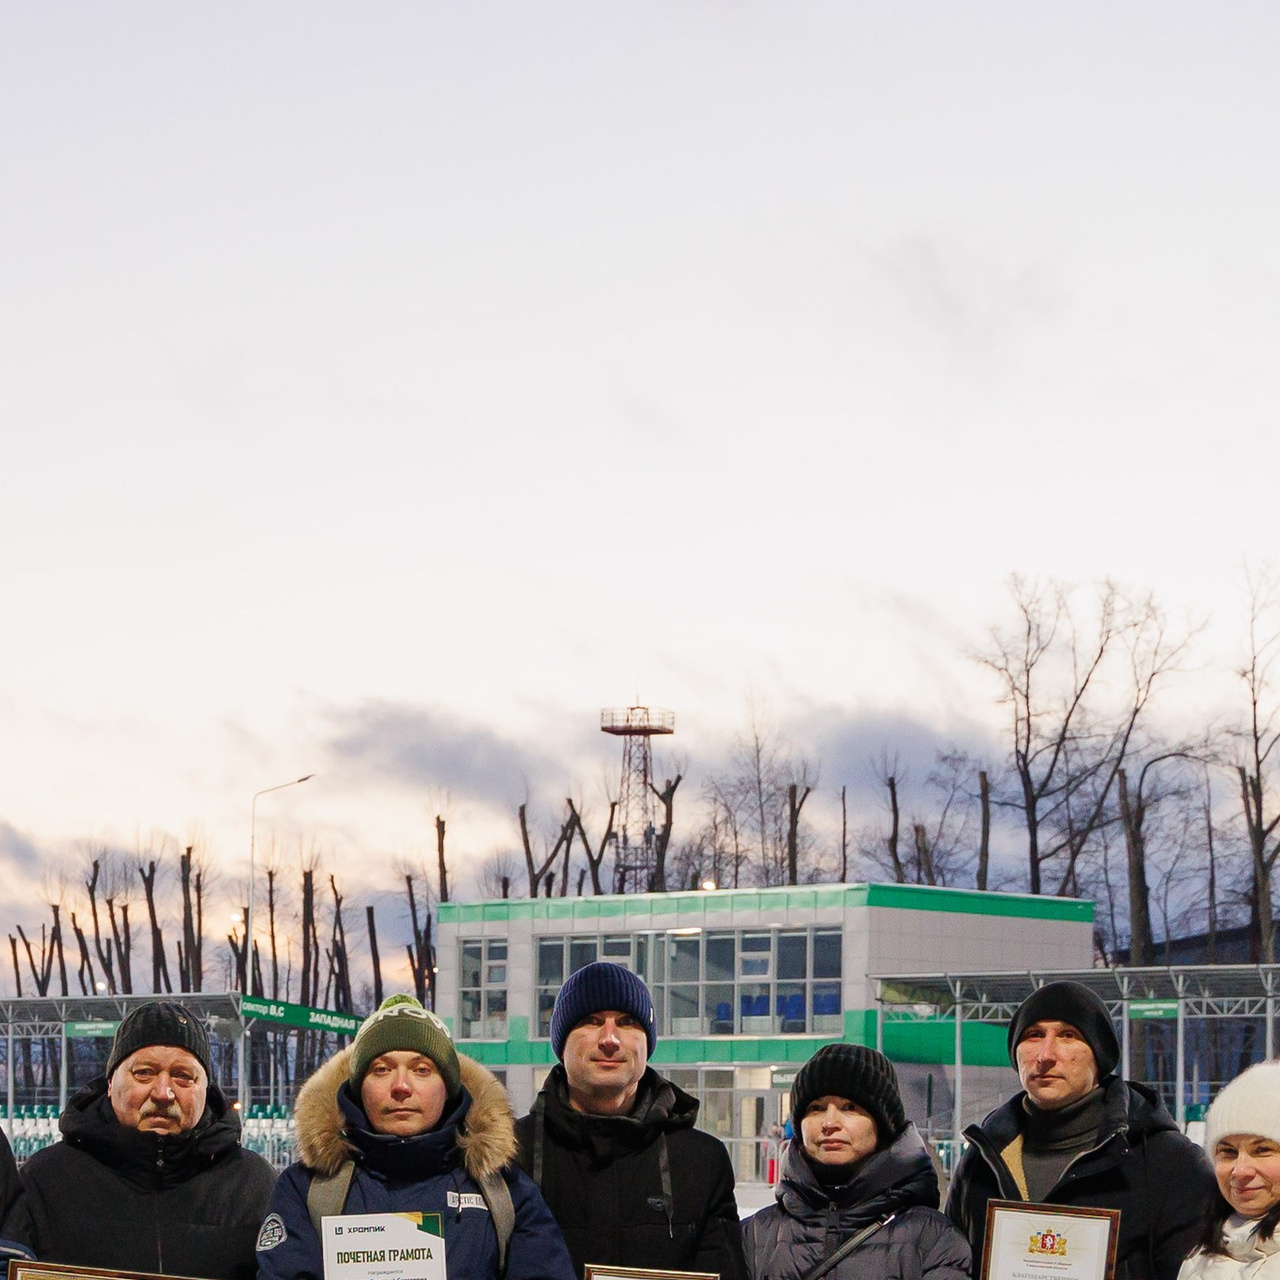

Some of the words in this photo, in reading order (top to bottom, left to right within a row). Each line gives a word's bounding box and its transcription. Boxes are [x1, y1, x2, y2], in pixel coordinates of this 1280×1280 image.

[308, 1012, 356, 1029] ЗАПАДНАЯ
[337, 1250, 386, 1264] ПОЧЕТНАЯ
[388, 1248, 433, 1262] ГРАМОТА
